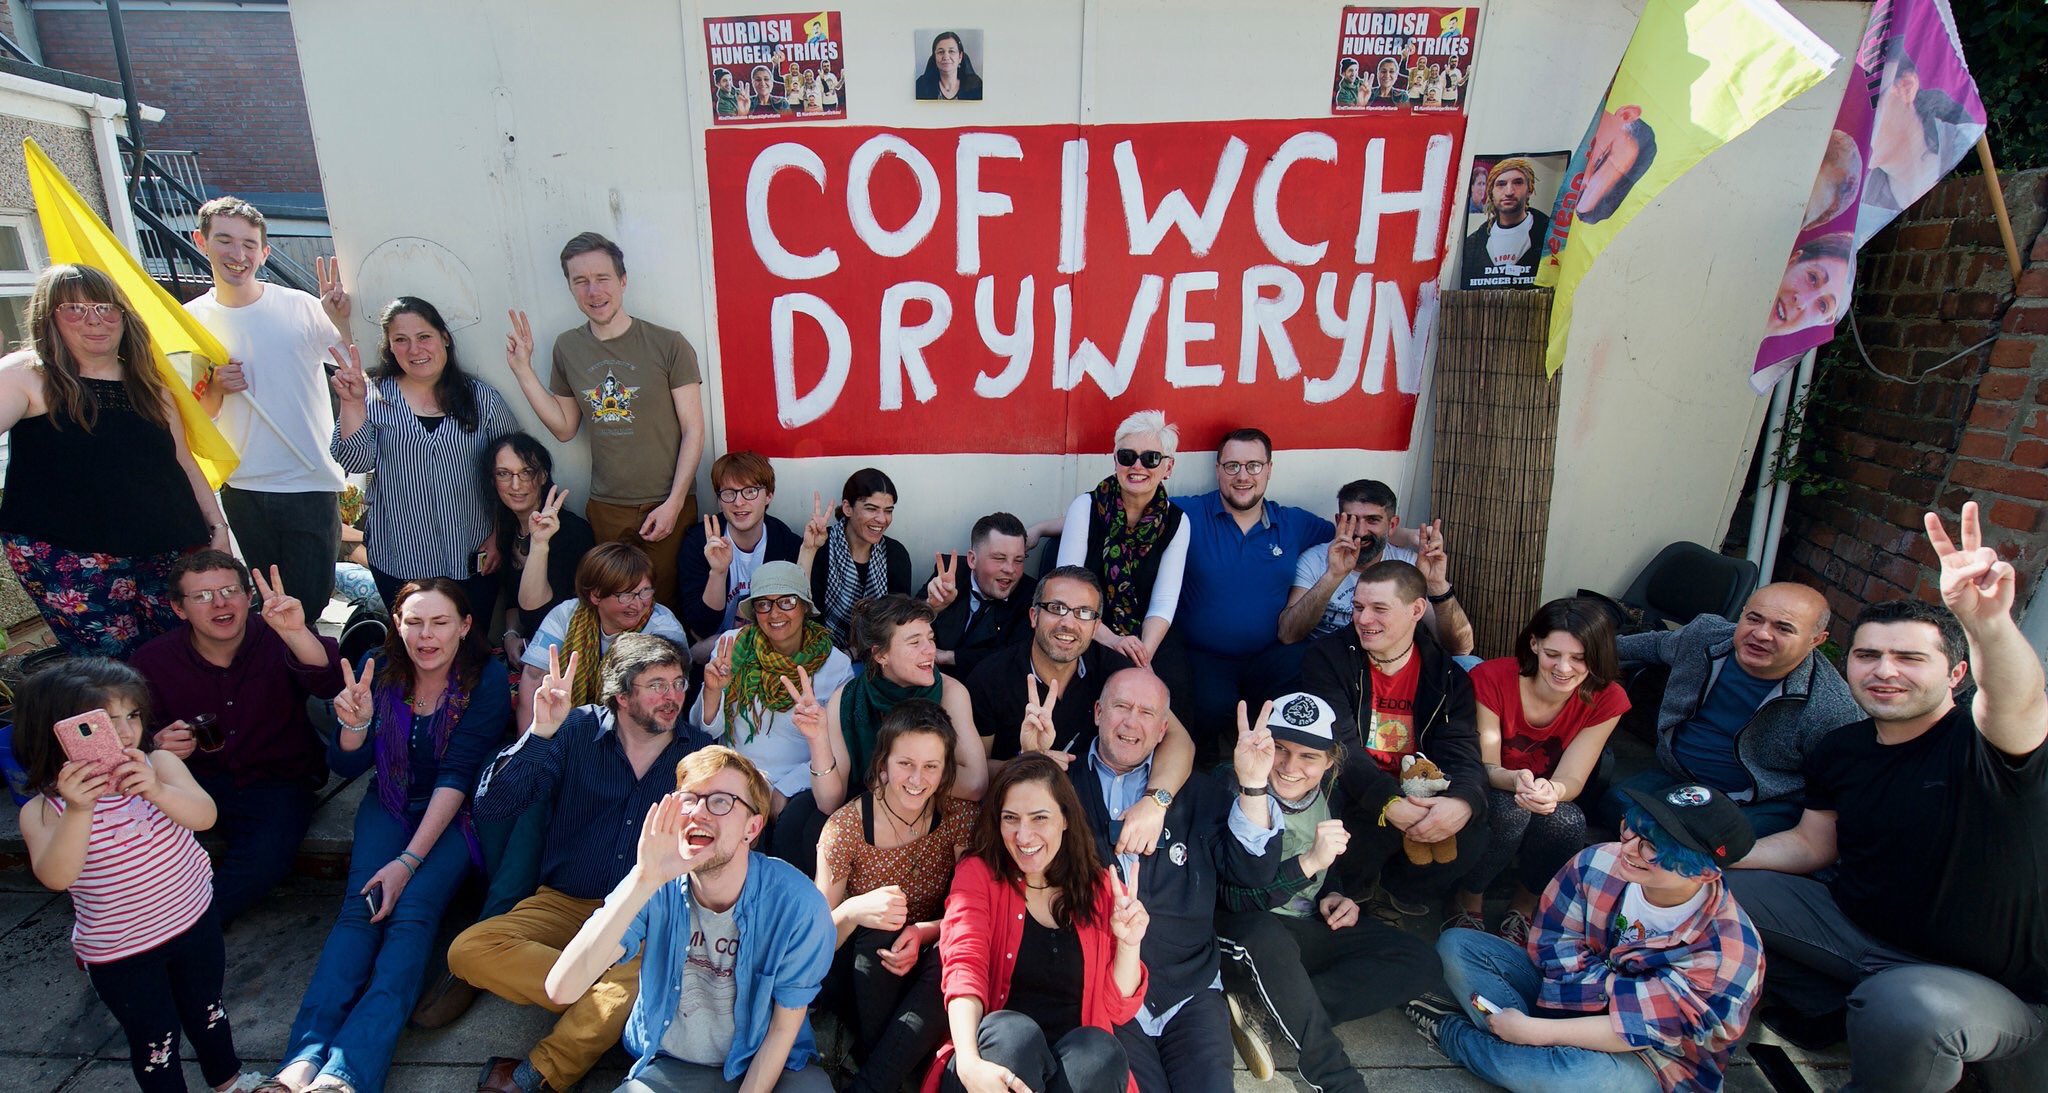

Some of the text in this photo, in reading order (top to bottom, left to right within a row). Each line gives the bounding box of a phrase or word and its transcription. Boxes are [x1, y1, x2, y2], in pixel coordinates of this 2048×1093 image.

[709, 20, 793, 46] KURDISH
[1345, 13, 1430, 36] KURDISH
[711, 41, 839, 65] HUNGER STRIKES
[1342, 37, 1470, 57] HUNGER STRIKES
[746, 131, 1454, 280] COFIWCH
[1470, 276, 1537, 286] HUNGER STRI
